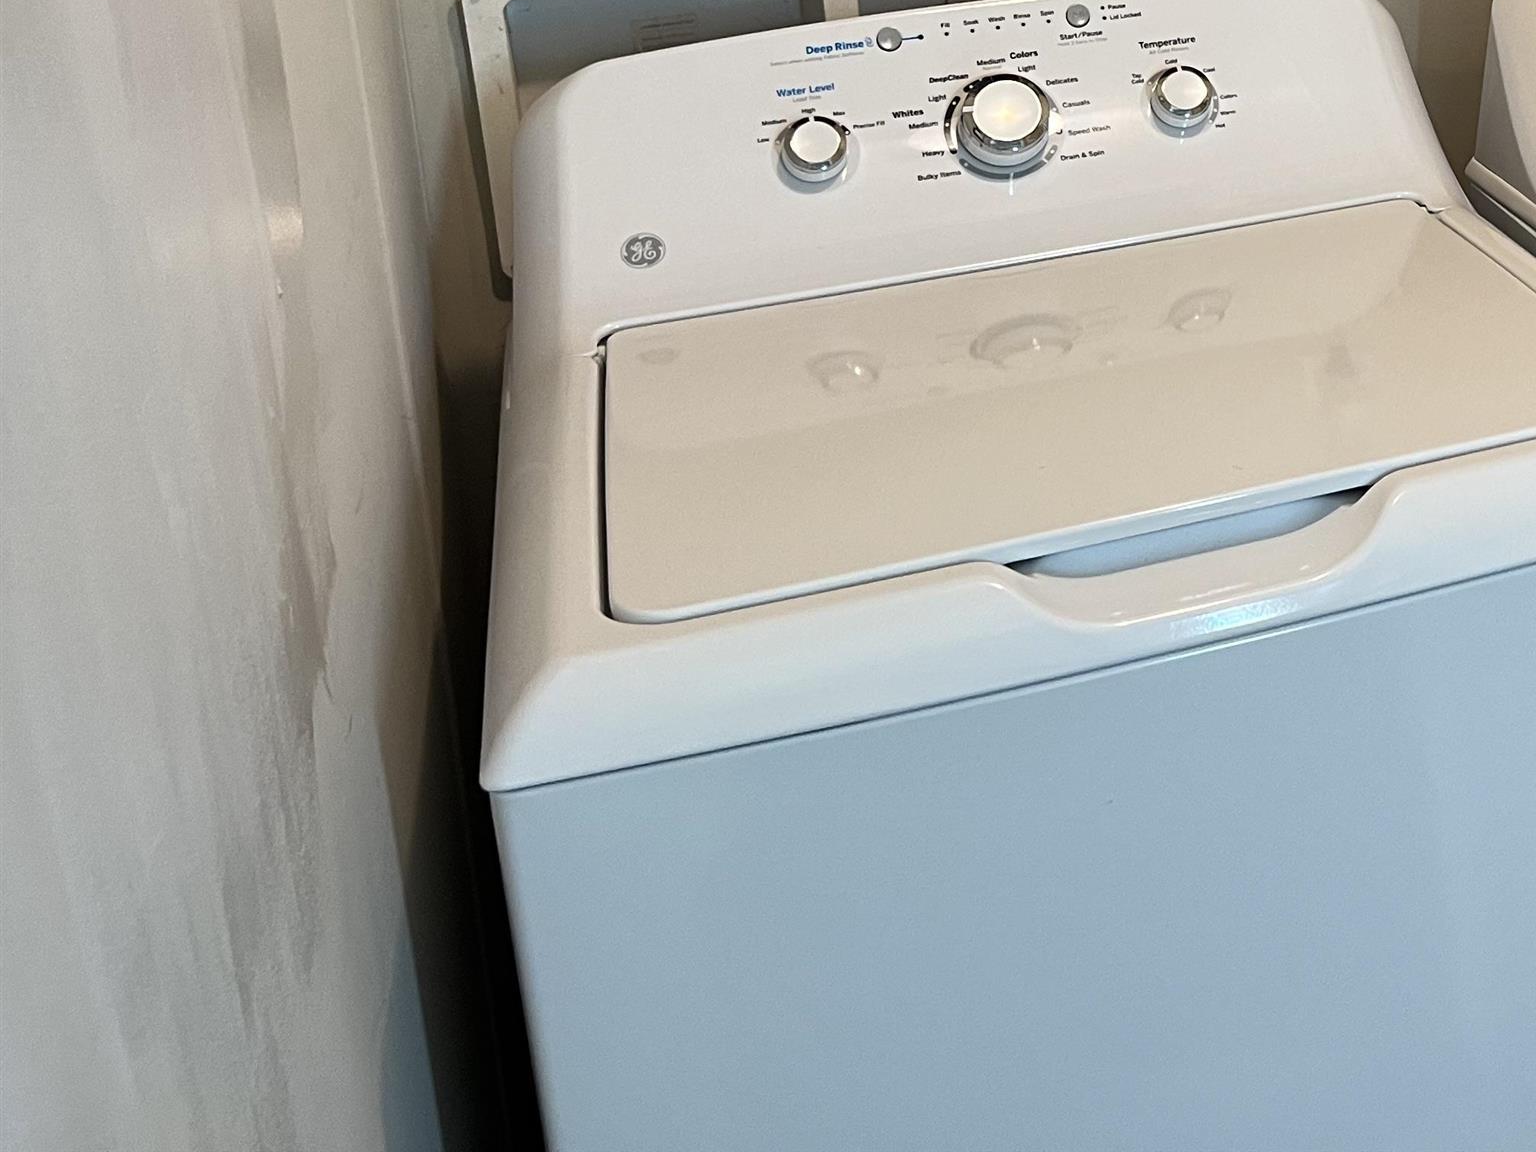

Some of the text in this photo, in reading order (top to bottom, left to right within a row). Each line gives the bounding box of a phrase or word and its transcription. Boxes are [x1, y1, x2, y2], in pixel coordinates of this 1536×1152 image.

[1013, 12, 1031, 20] Rinse
[1040, 9, 1055, 17] Spin
[1120, 11, 1142, 20] Locked
[963, 18, 979, 26] Soak
[988, 15, 1006, 23] Wash
[1059, 29, 1103, 42] Start/Pause
[806, 40, 865, 55] Deep Rinse
[1138, 36, 1196, 50] Temperature
[1009, 50, 1039, 60] Colors
[976, 57, 1006, 67] Medium
[1017, 64, 1036, 73] Light
[929, 73, 969, 85] DeepClean
[1046, 76, 1079, 86] Delicates
[776, 83, 835, 97] Water Level
[928, 94, 947, 103] Light
[1062, 99, 1090, 109] Casuals
[892, 108, 924, 119] Whites
[908, 120, 939, 130] Medium
[1068, 124, 1111, 137] Speed Wash
[922, 149, 945, 158] Heavy
[1060, 153, 1081, 162] Drain
[1088, 150, 1105, 159] Spin
[917, 169, 961, 182] Bulky Items
